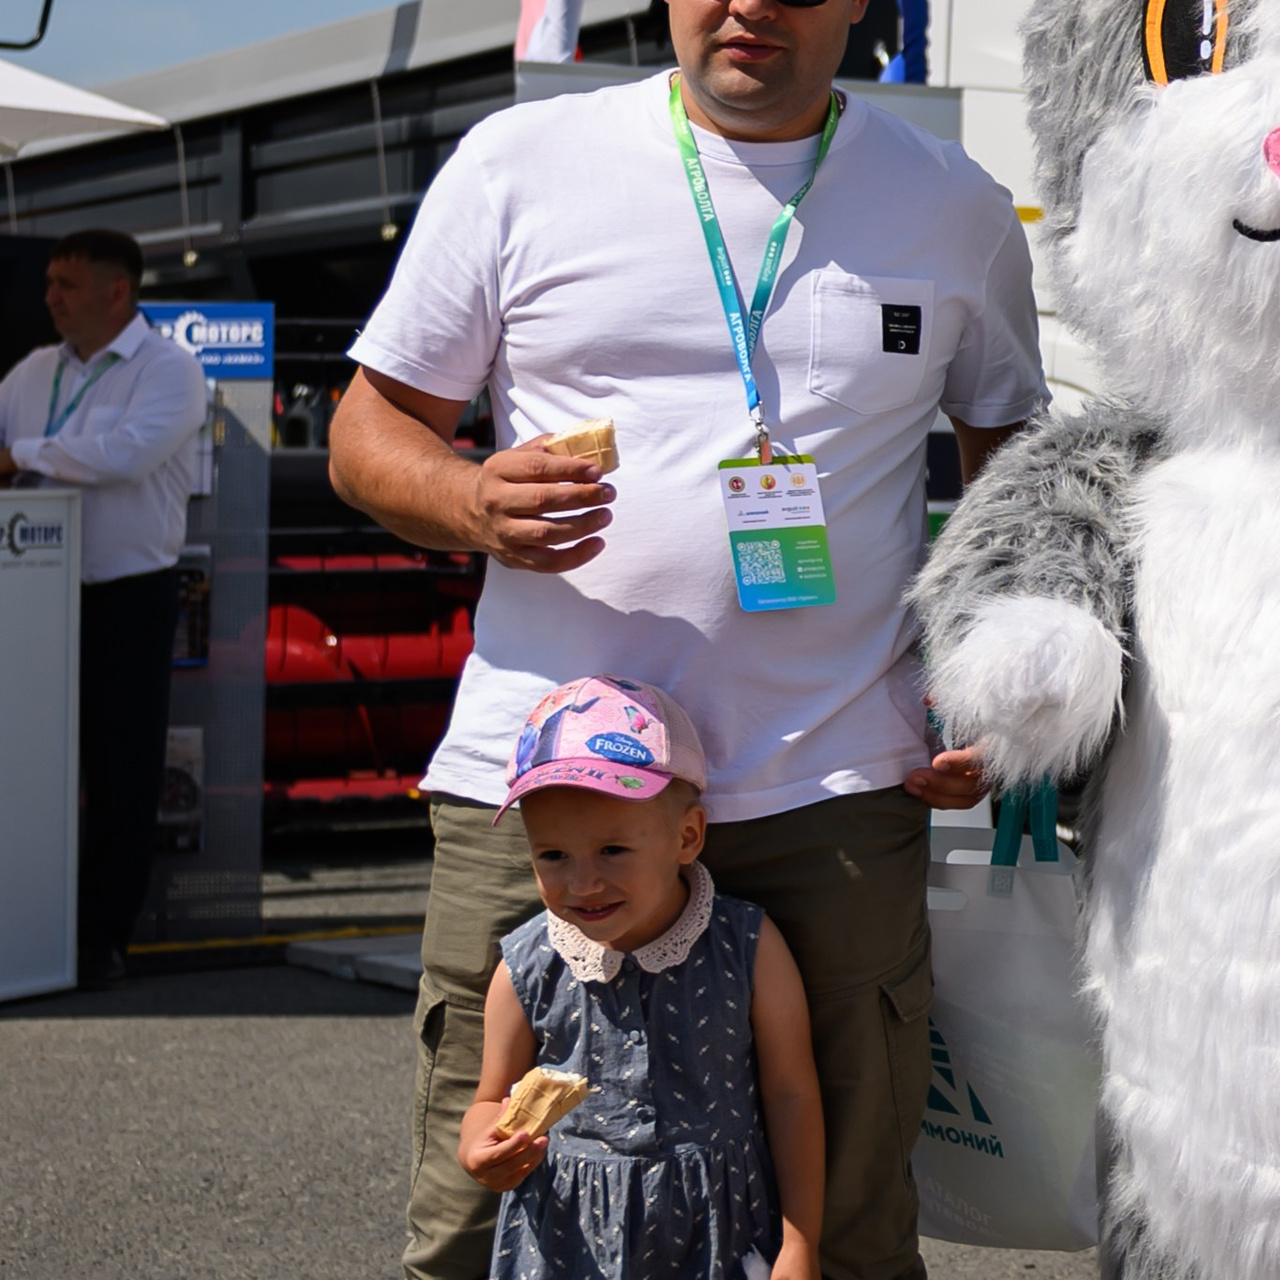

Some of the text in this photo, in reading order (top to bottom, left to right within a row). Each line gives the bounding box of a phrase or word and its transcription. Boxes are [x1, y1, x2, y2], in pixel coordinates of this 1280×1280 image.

[686, 157, 716, 223] АГРОВОЛГА
[191, 321, 264, 343] МОТОРС
[729, 311, 752, 384] АГРОВОЛГА
[594, 738, 647, 761] FROZEN
